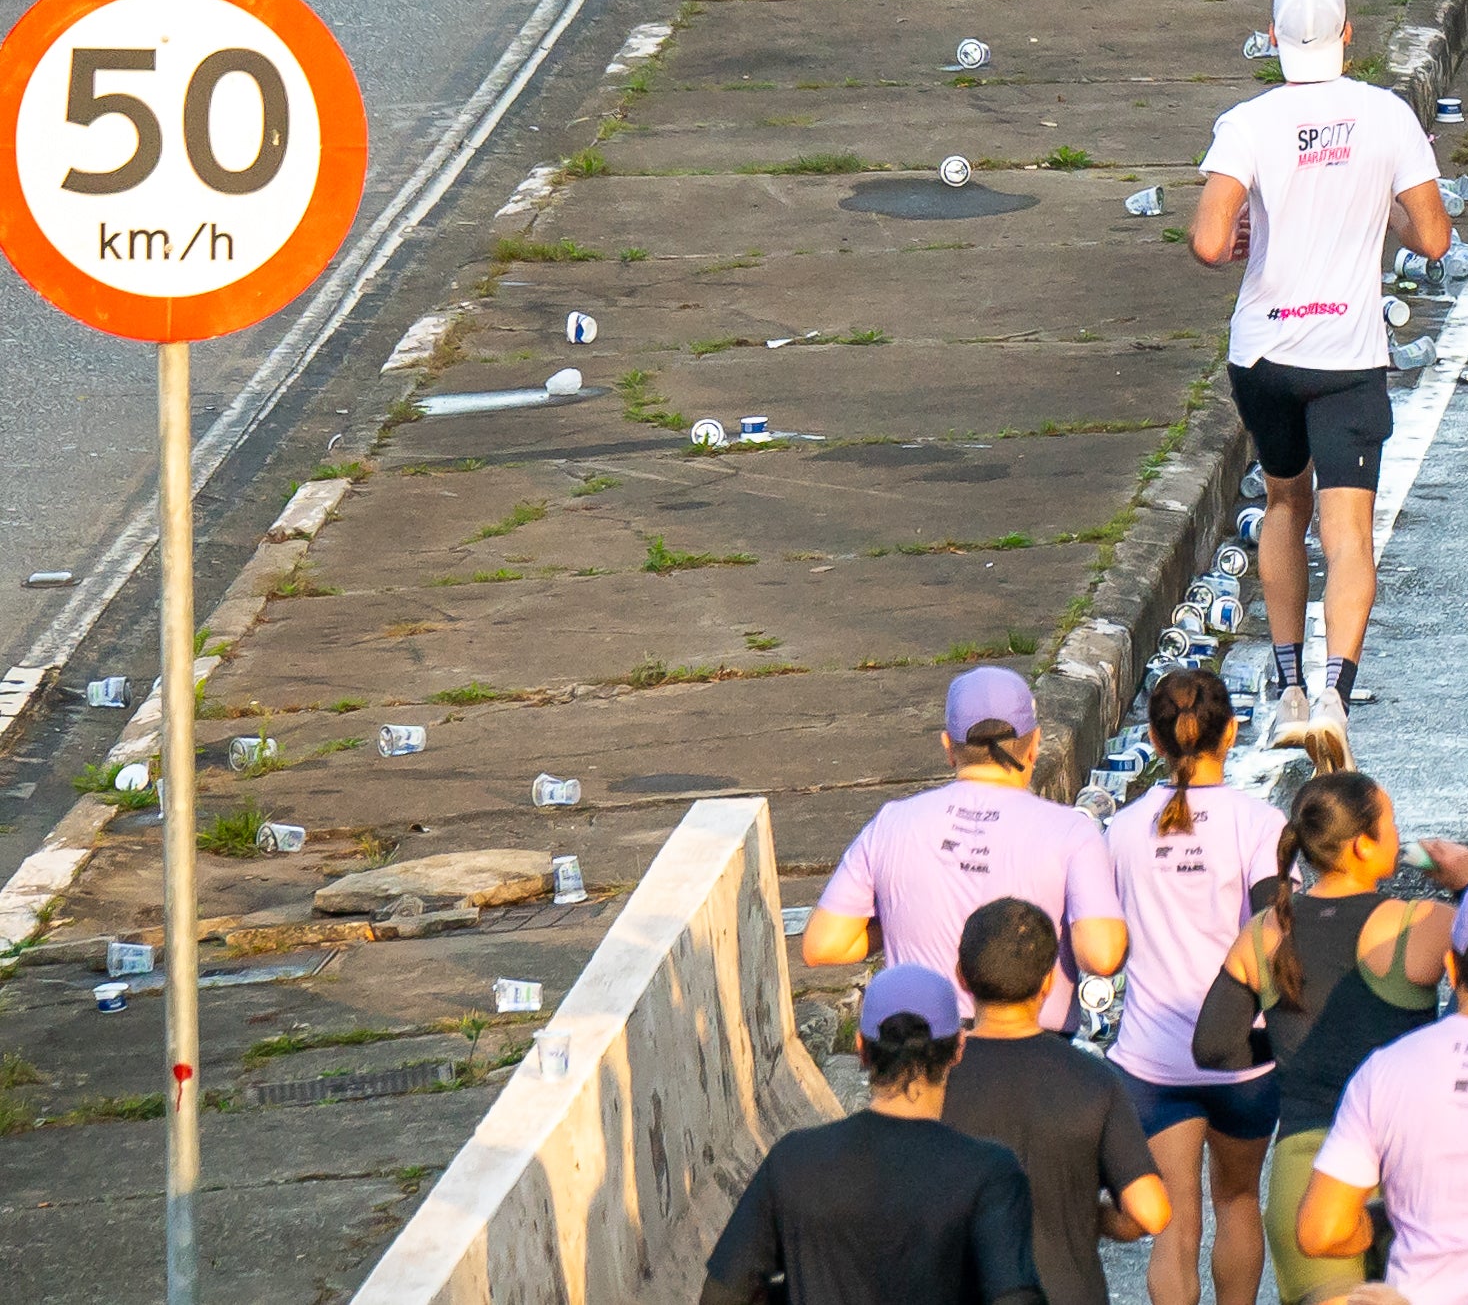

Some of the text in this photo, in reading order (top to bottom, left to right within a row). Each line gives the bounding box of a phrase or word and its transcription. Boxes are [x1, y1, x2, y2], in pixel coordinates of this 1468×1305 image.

[60, 46, 290, 197] 50
[1297, 146, 1351, 168] MARATHON
[98, 221, 235, 261] km/h
[980, 810, 1001, 823] 25
[1193, 811, 1209, 824] 25
